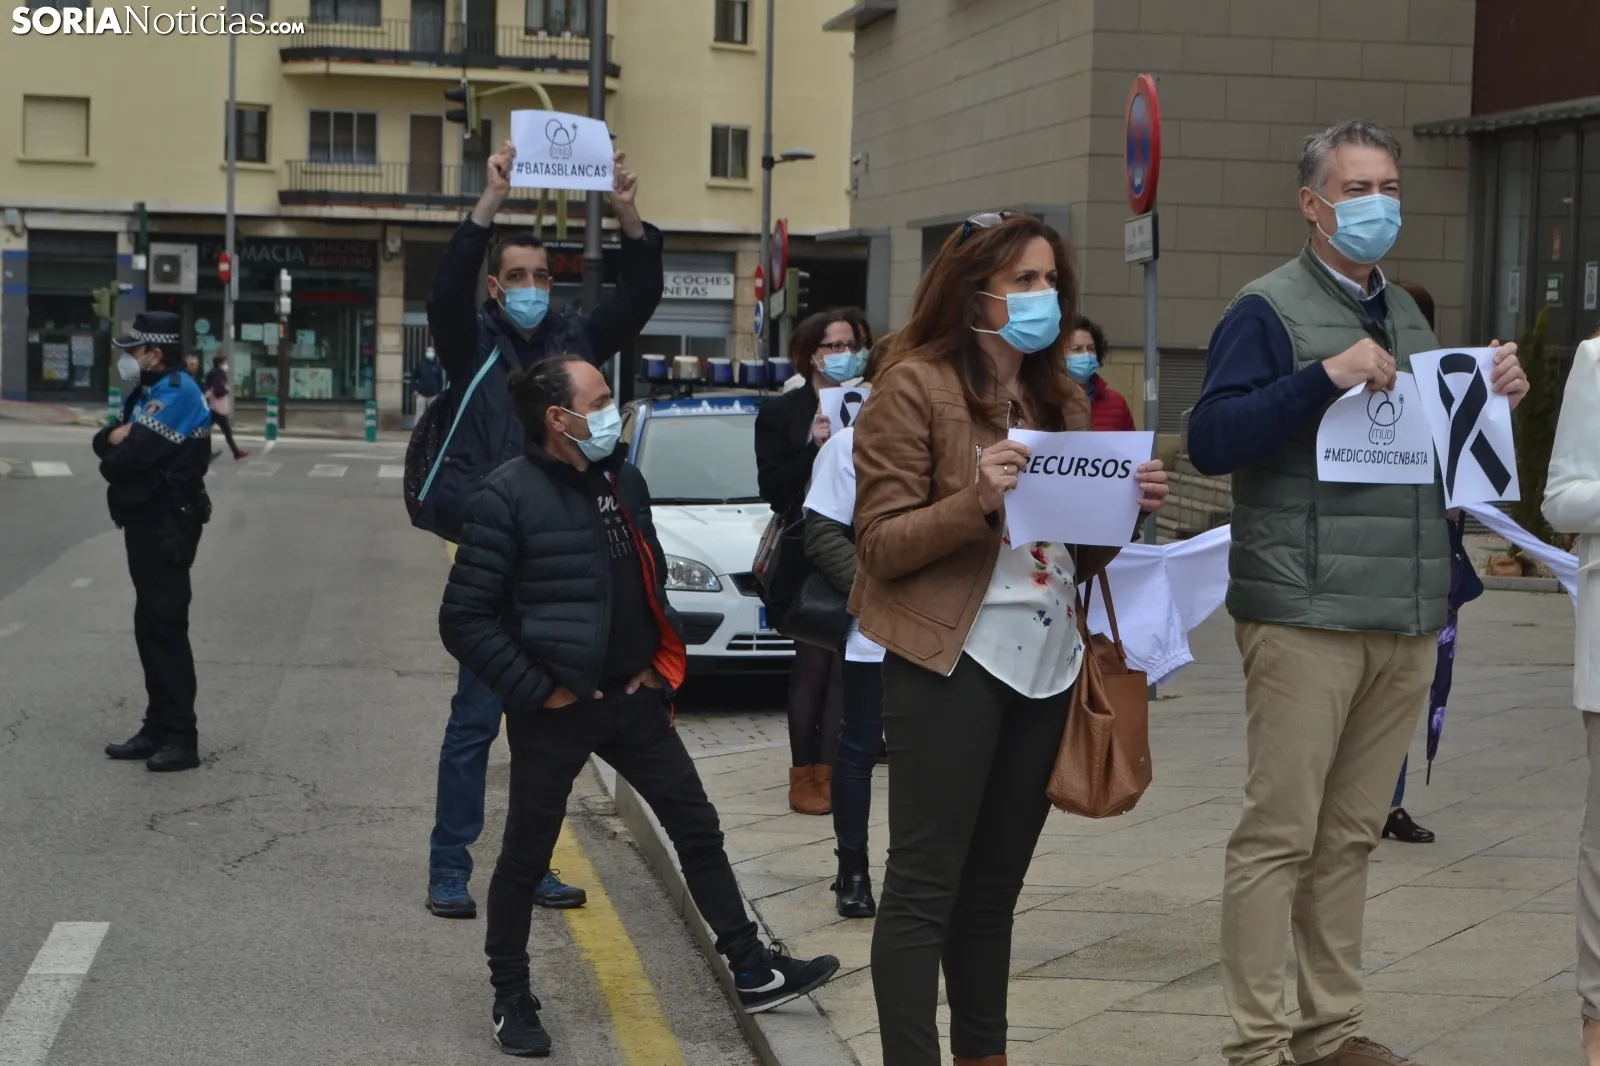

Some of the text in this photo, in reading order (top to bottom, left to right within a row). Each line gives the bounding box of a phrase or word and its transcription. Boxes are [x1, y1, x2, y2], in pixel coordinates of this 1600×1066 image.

[516, 161, 607, 178] #BATASBLANCAS
[201, 243, 305, 263] FAMACIA
[672, 275, 731, 286] COCHES
[1324, 448, 1428, 465] #MEDICOSDICENBASTA
